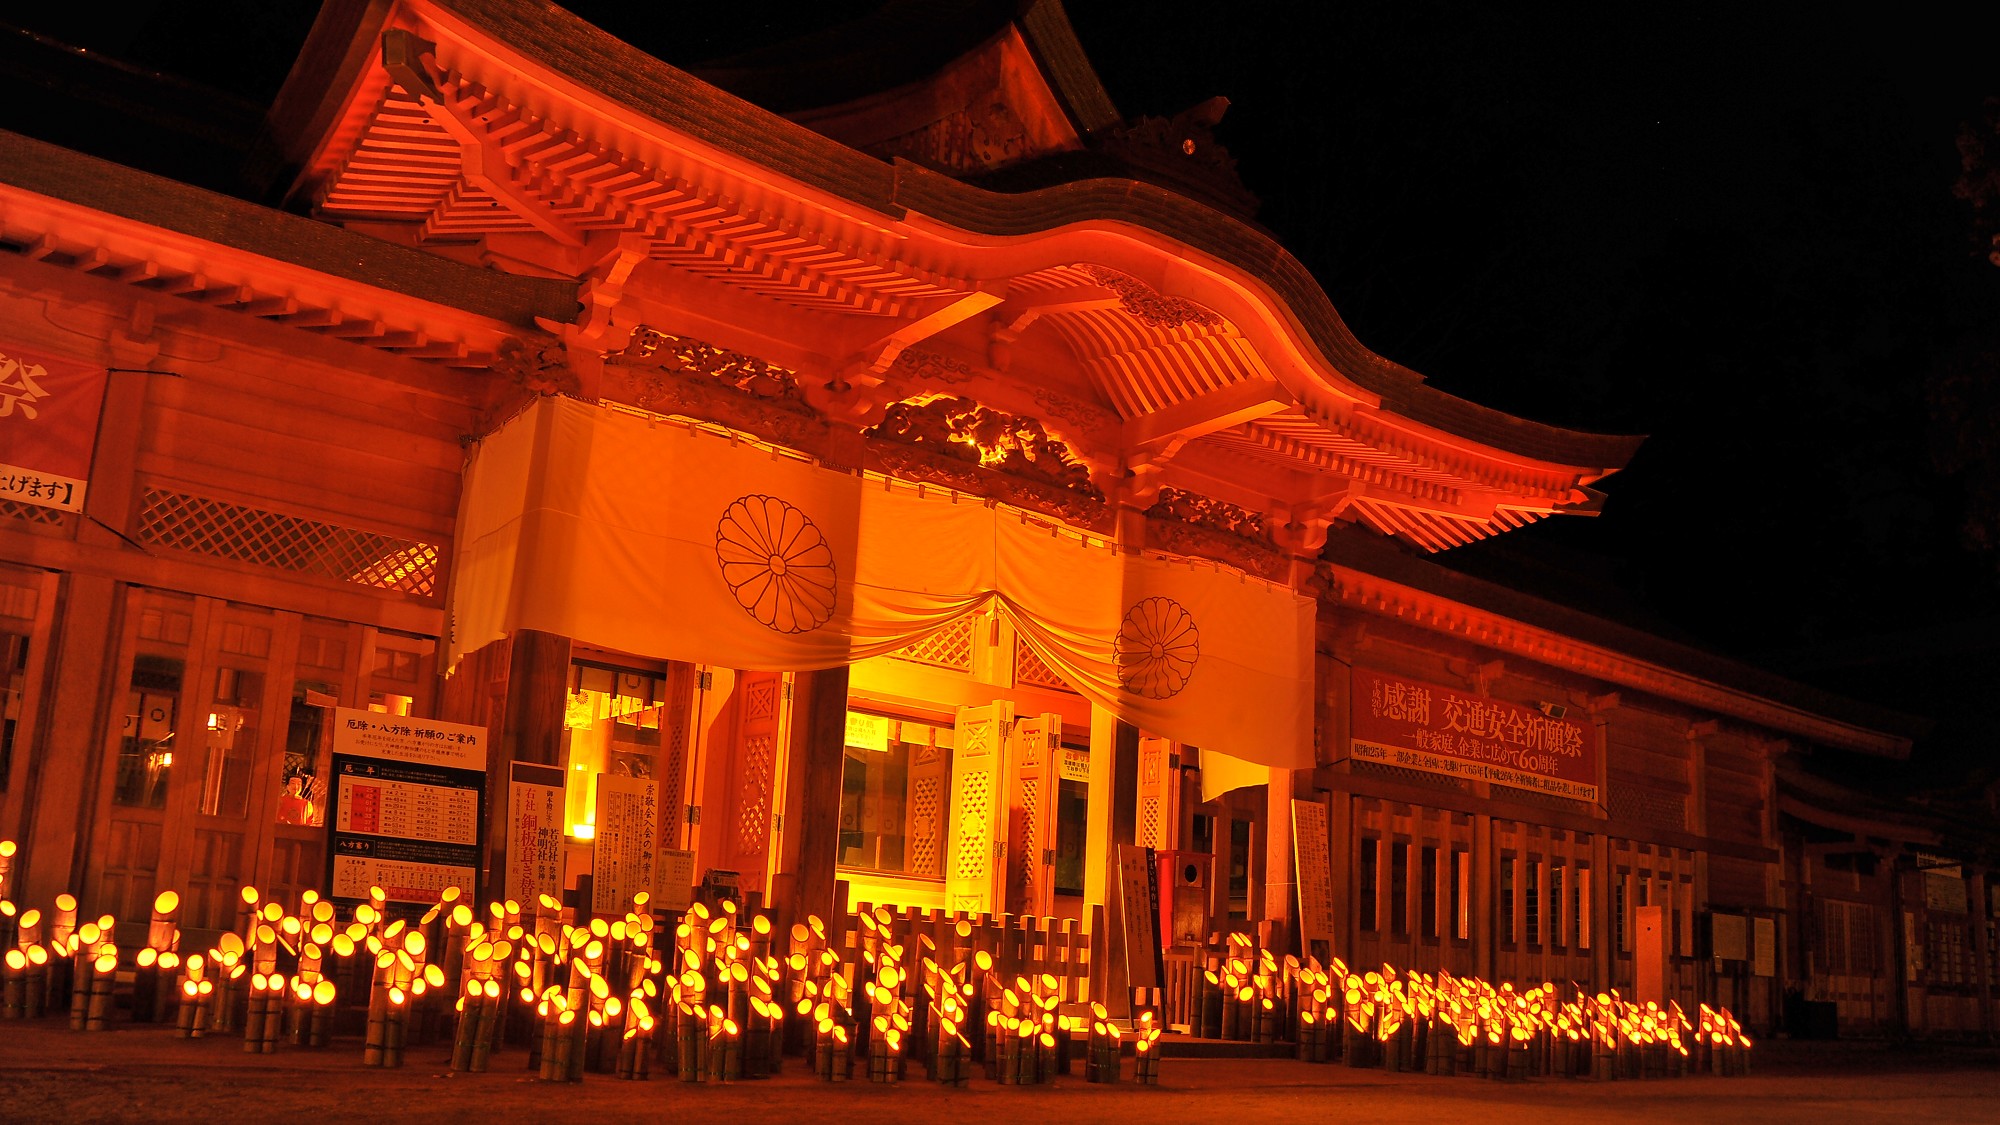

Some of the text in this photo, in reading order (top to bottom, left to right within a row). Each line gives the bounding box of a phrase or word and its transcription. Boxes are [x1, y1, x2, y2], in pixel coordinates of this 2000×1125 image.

[1371, 679, 1382, 718] 平成26年
[1382, 682, 1584, 758] 感謝 交通安全祈願祭
